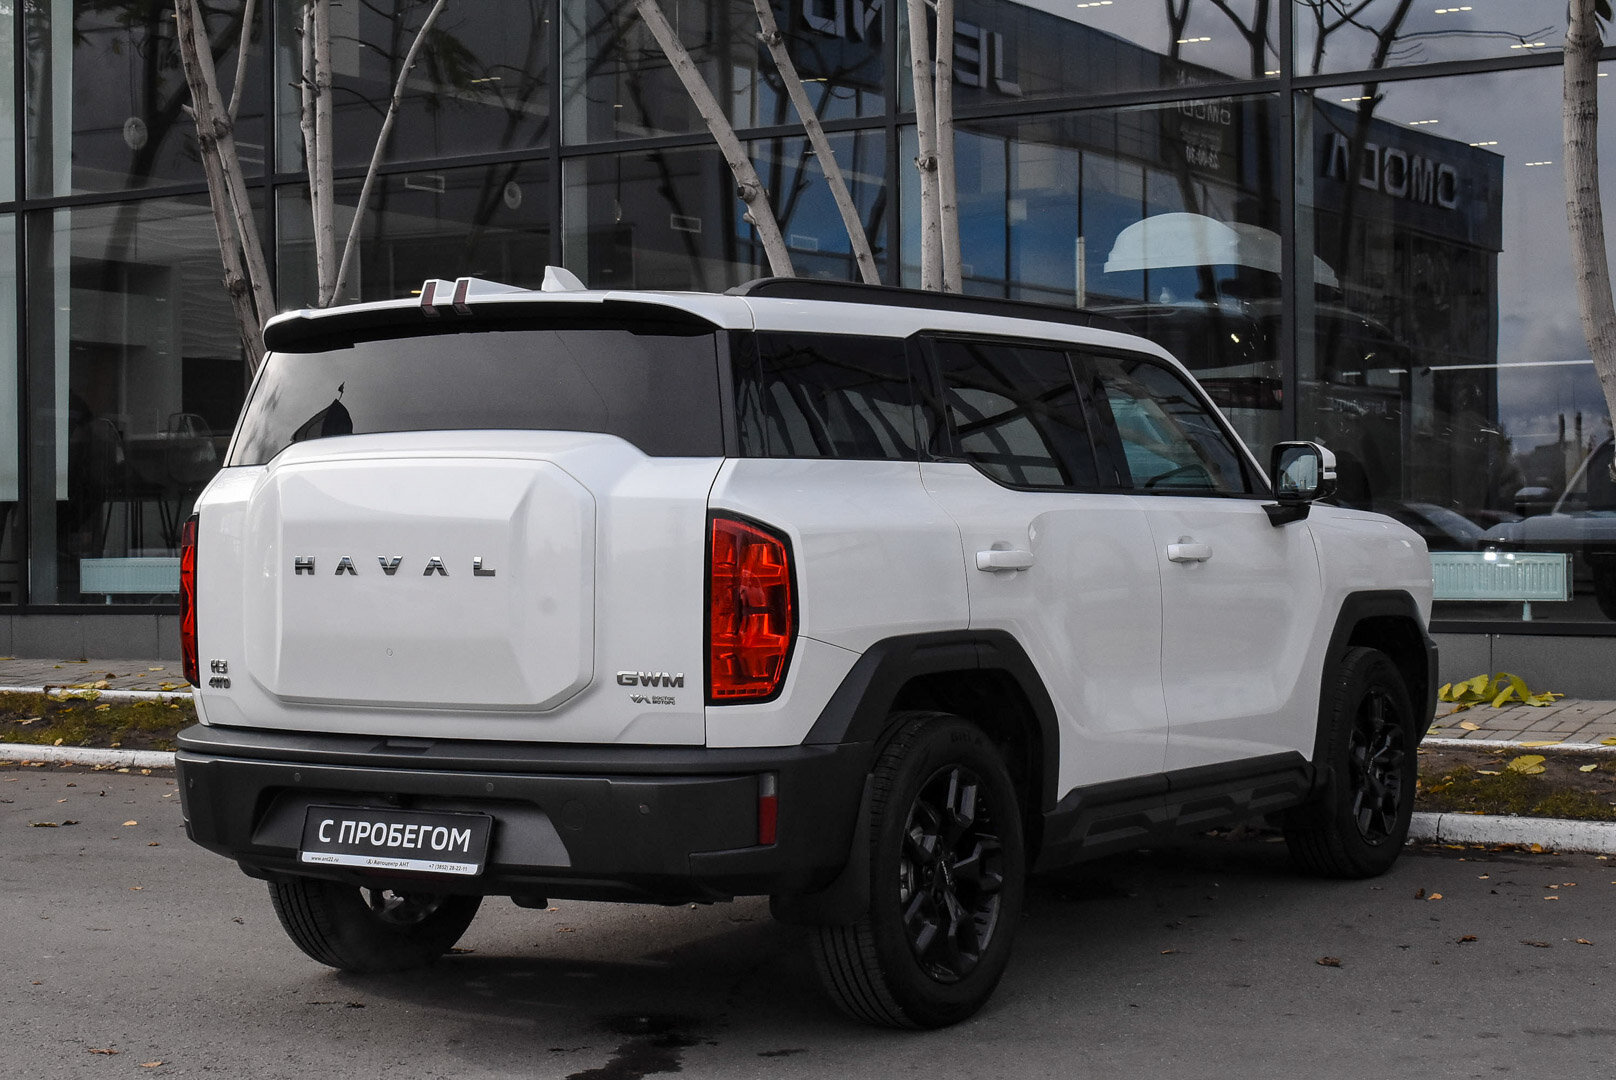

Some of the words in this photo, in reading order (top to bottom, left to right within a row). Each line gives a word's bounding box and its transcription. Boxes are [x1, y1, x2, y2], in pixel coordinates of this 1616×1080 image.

[294, 555, 496, 577] HAVAL
[616, 671, 684, 688] GWM
[318, 819, 334, 843] С
[338, 820, 471, 853] ПРОБЕГОМ
